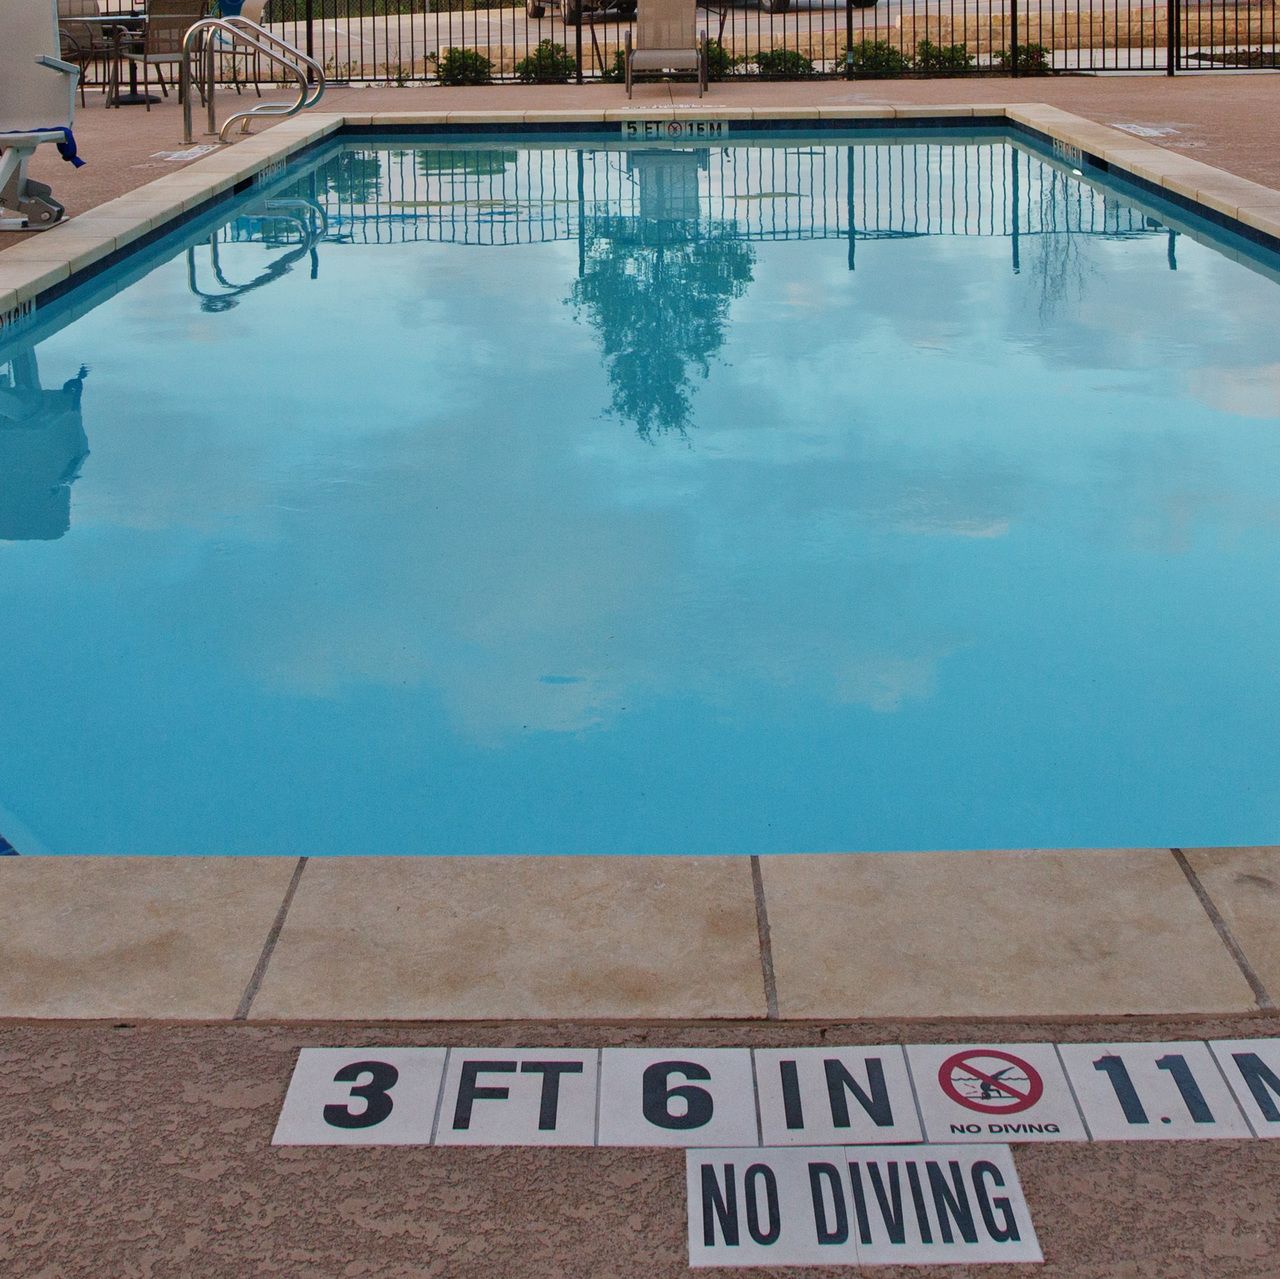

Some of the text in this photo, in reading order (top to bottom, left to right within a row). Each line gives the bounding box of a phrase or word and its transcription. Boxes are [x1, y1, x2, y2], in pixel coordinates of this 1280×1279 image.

[321, 1060, 401, 1130] 3
[452, 1060, 585, 1131] FT
[640, 1059, 715, 1130] 6
[781, 1056, 888, 1131] IN
[1091, 1053, 1217, 1125] 1.1
[949, 1121, 1062, 1136] NO DIVING
[701, 1157, 1020, 1248] NO DIVING
